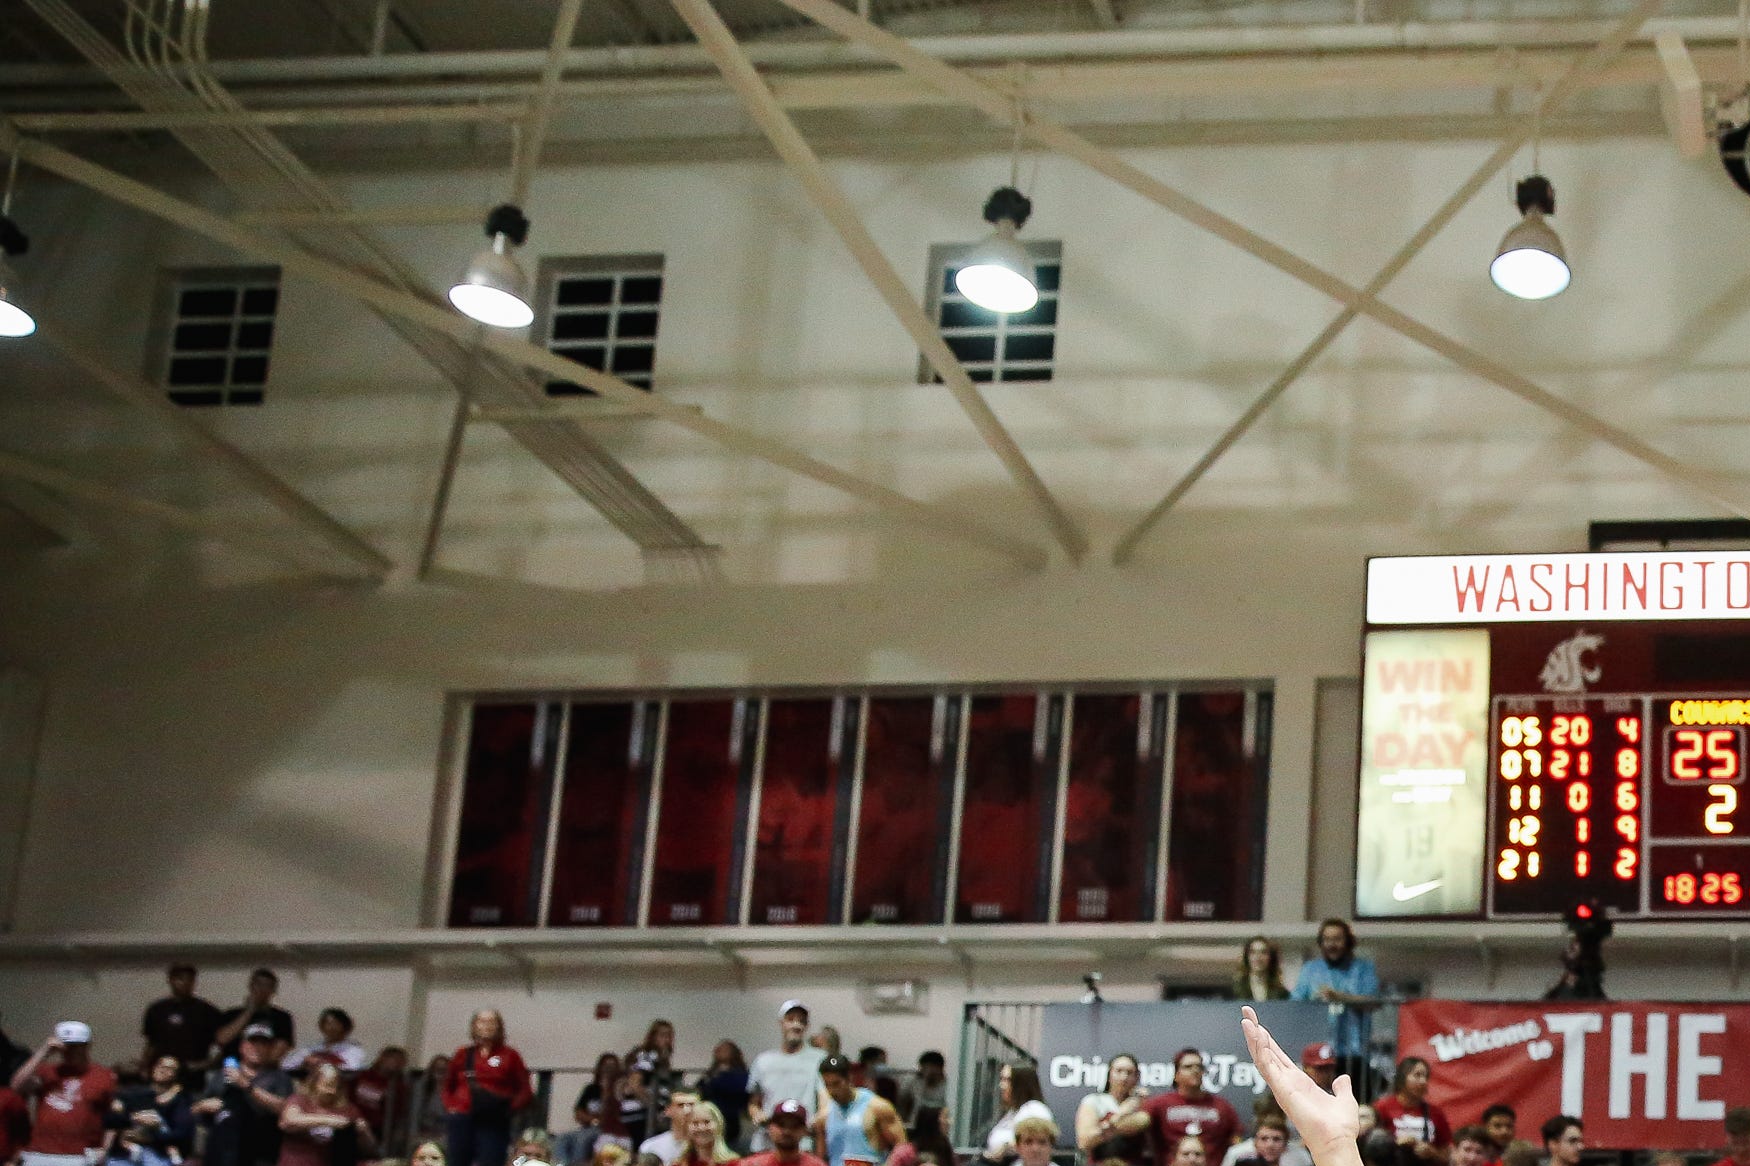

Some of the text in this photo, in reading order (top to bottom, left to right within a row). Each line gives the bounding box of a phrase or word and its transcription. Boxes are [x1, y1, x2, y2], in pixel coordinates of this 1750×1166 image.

[1376, 658, 1474, 694] WIN
[1501, 714, 1640, 747] 05 20 4
[1373, 731, 1476, 768] DAY
[1500, 747, 1639, 780] 07 21 8
[1673, 729, 1740, 781] 25
[1509, 780, 1639, 812] 11 0 6
[1704, 783, 1738, 834] 2
[1508, 813, 1639, 847] 12 1 9
[1498, 846, 1638, 880] 21 1 2
[1664, 872, 1697, 905] 18
[1700, 871, 1743, 905] 25
[1428, 1018, 1542, 1062] Welcome
[1544, 1011, 1727, 1121] THE
